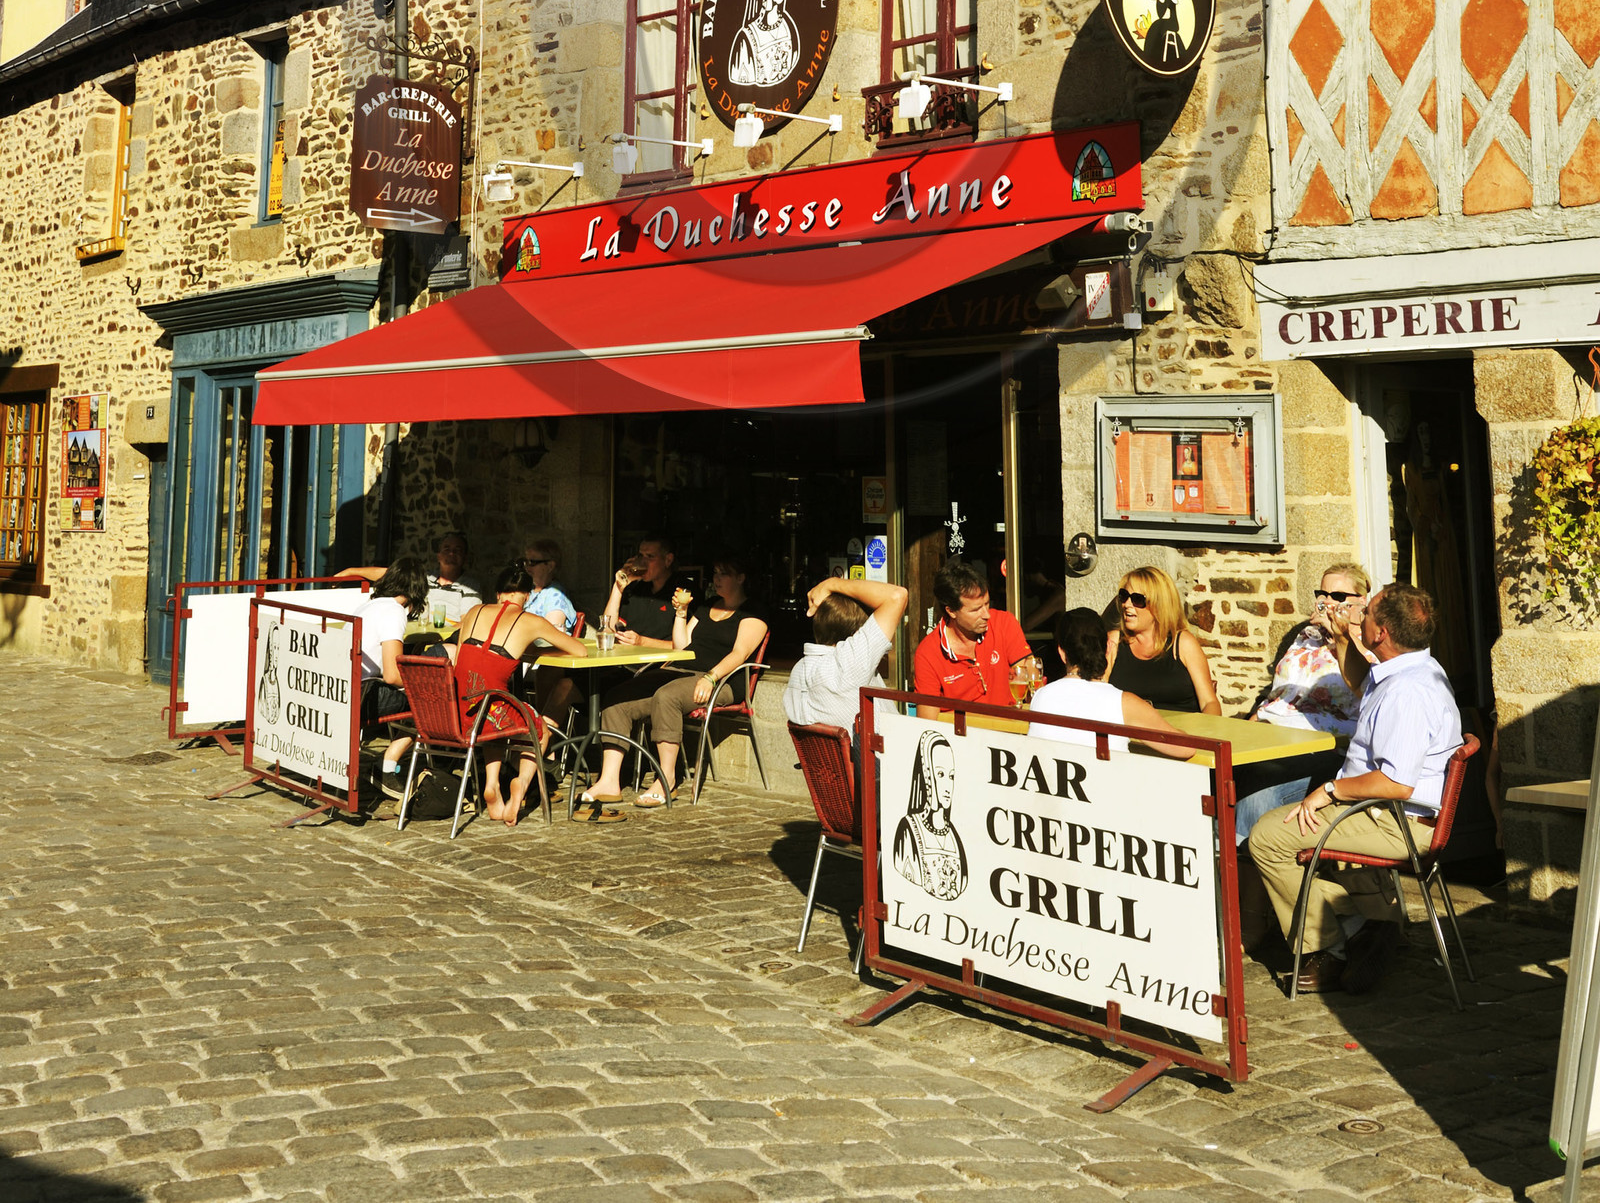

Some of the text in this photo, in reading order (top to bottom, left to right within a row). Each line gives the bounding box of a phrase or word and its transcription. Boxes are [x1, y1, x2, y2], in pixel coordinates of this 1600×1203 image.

[704, 55, 718, 91] La
[797, 29, 830, 99] Anne
[388, 107, 431, 123] GRILL
[394, 128, 423, 148] La
[360, 149, 454, 179] Duchesse
[376, 181, 438, 205] Anne
[580, 169, 1011, 261] La Duchesse Anne
[1278, 296, 1521, 345] CREPERIE
[289, 629, 319, 658] BAR
[287, 665, 348, 704] CREPERIE
[286, 701, 333, 738] GRILL
[255, 728, 347, 777] La Duchesse Anne
[987, 746, 1092, 803] BAR
[986, 806, 1200, 890] CREPERIE
[989, 867, 1152, 943] GRILL
[891, 900, 1213, 1017] La Duchesse Anne
